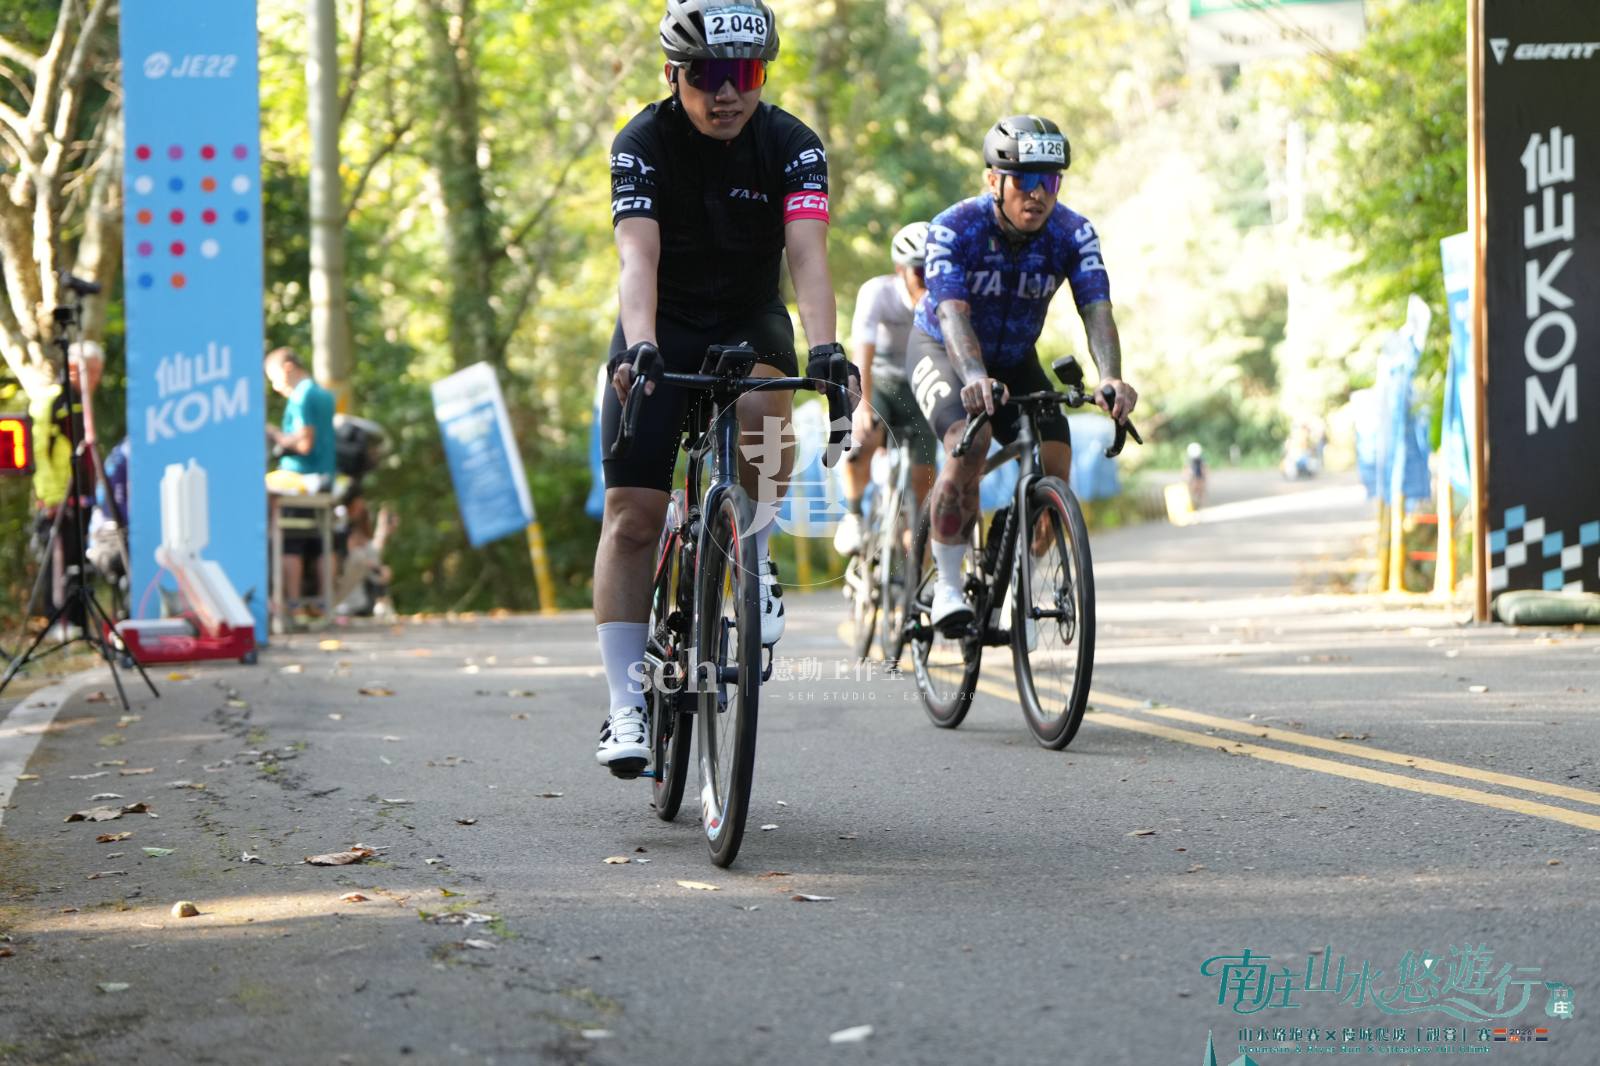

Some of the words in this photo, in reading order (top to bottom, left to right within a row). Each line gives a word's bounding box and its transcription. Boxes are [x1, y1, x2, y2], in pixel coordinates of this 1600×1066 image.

[1513, 42, 1600, 60] GIANT
[1524, 249, 1578, 436] KOM
[146, 377, 249, 443] KOM
